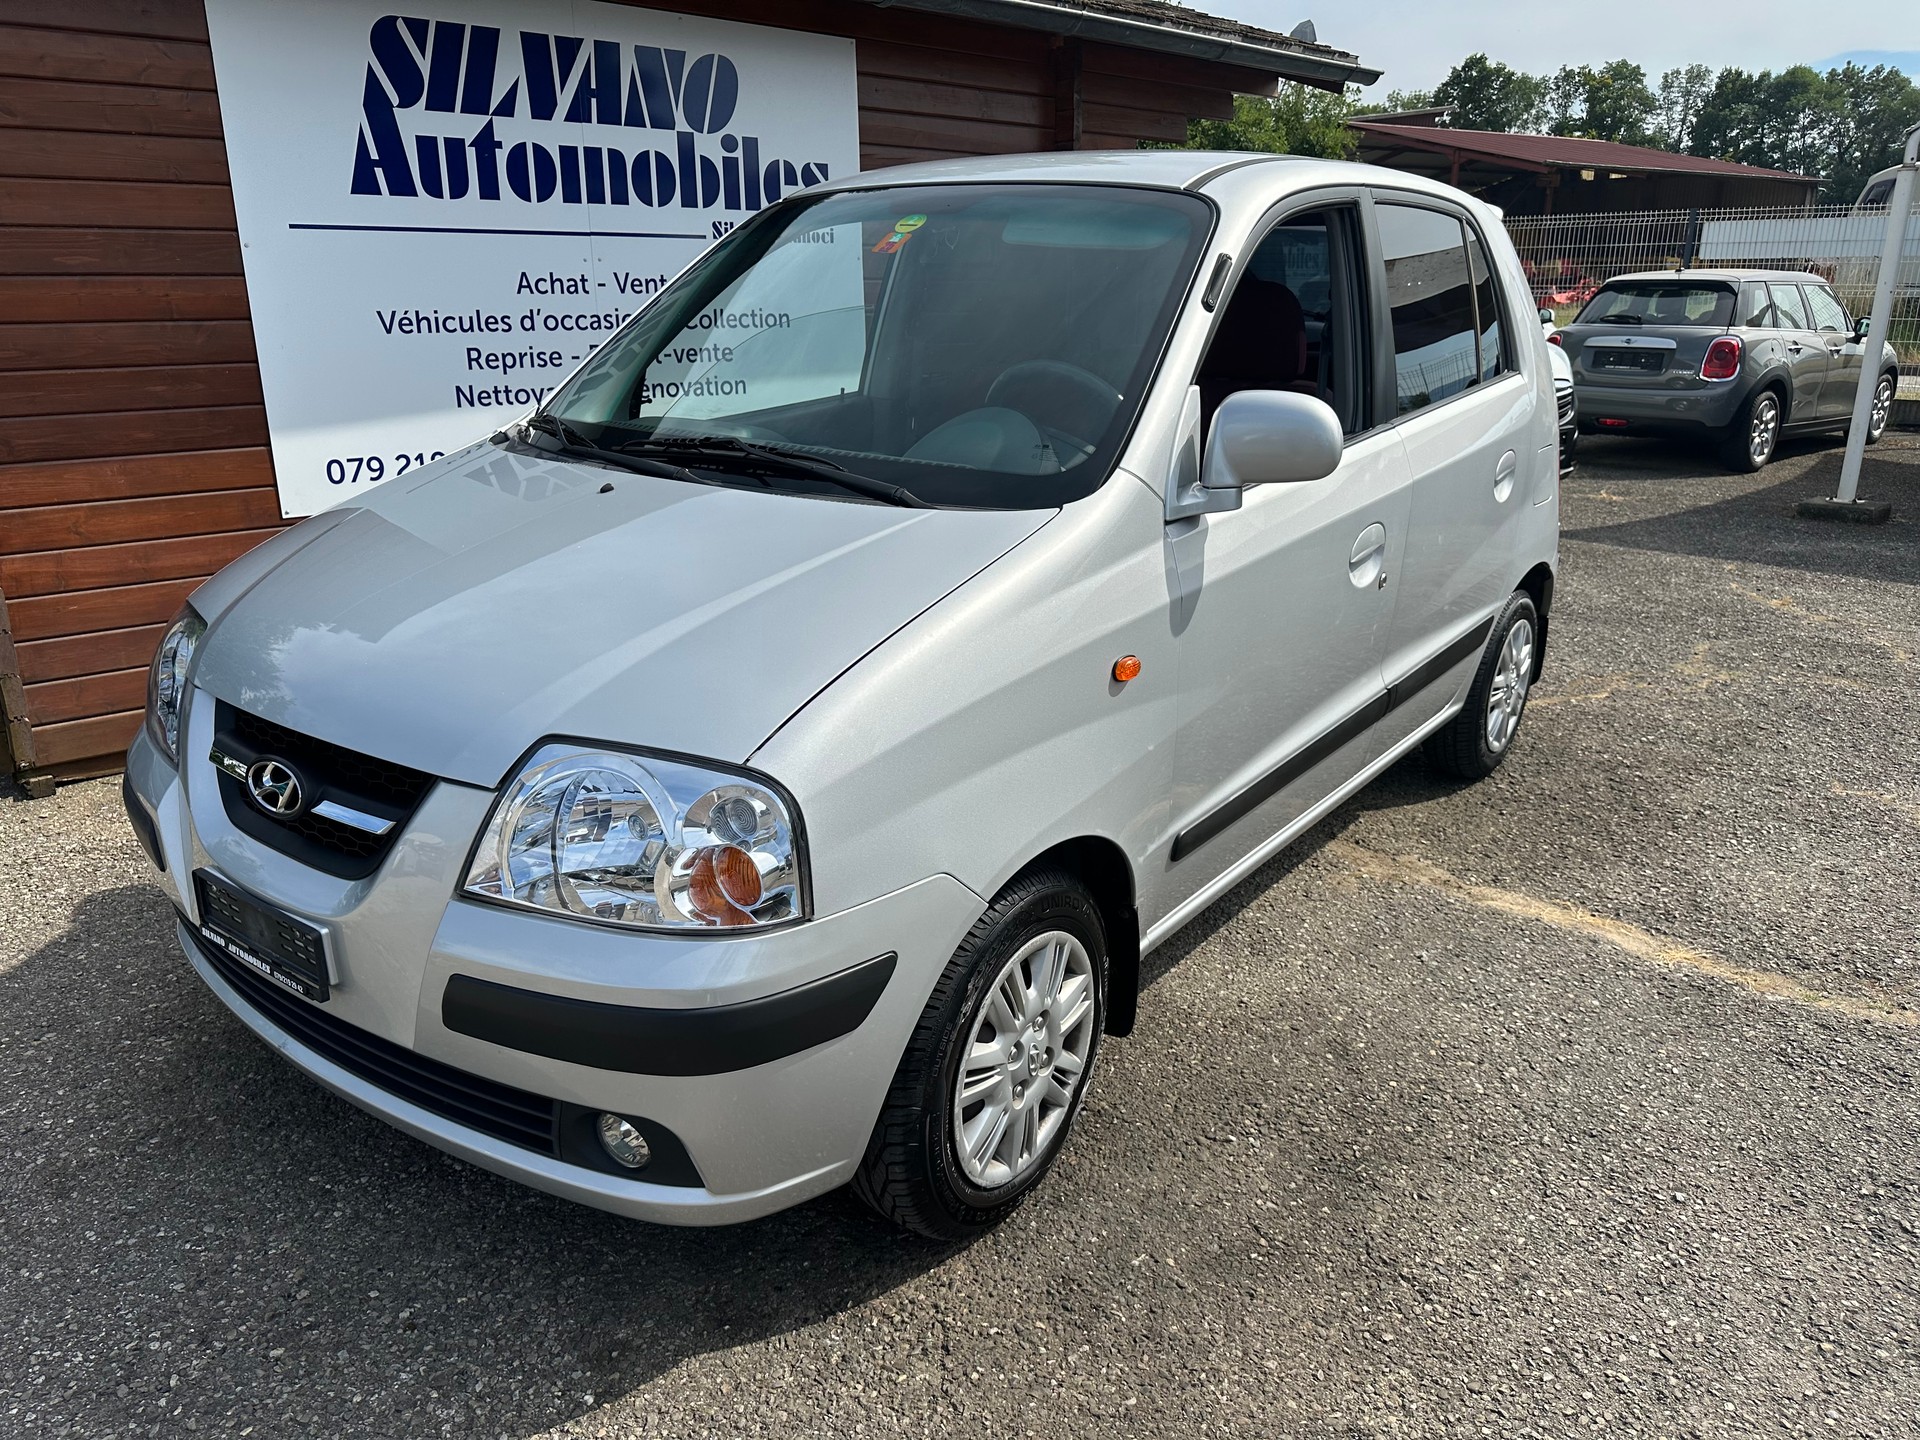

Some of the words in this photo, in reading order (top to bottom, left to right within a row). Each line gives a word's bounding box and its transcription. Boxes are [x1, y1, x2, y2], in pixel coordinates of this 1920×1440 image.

[362, 14, 739, 135] SILVANO
[350, 106, 829, 212] Automobiles
[516, 271, 590, 295] Achat
[613, 271, 669, 295] Vent
[375, 309, 513, 335] Véhicules
[519, 308, 633, 332] d'occasi
[465, 345, 564, 376] Reprise
[454, 384, 556, 410] Nettoy
[326, 456, 386, 486] 079
[201, 926, 226, 948] SILVANO
[227, 942, 271, 975] AUTOMOBILES
[931, 1021, 954, 1079] OUTSIDE
